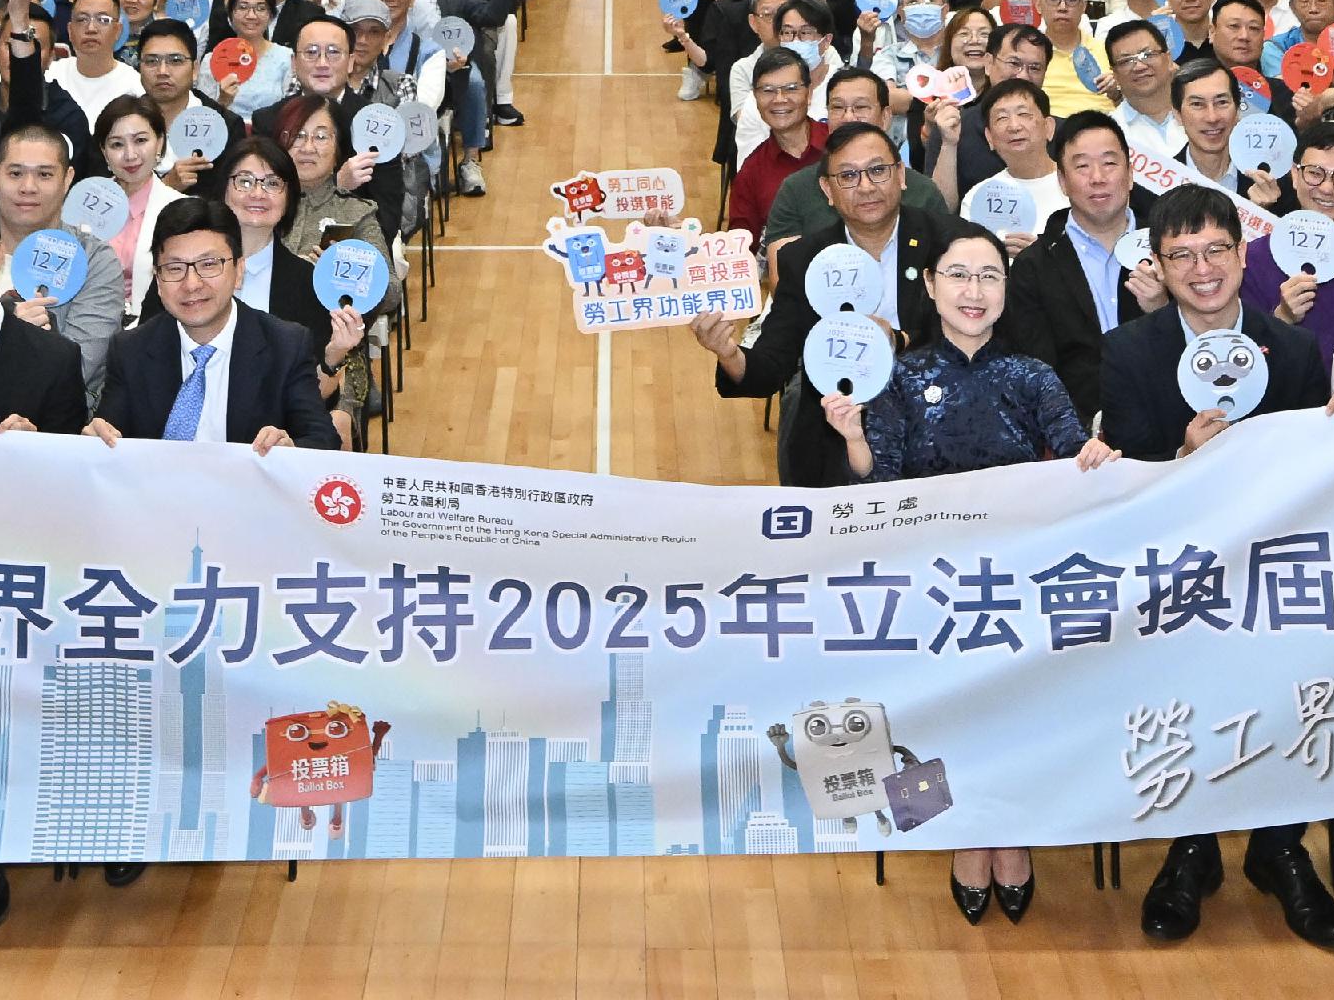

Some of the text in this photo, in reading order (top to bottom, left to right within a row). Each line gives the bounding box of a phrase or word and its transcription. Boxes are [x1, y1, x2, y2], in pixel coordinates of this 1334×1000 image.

[607, 176, 667, 194] 勞工同心
[616, 194, 675, 212] 投選賢能
[702, 236, 747, 258] 12.7
[688, 260, 752, 285] 齊投票
[584, 287, 755, 326] 勞工界功能界別
[381, 492, 460, 510] 勞工及福利局
[383, 476, 593, 507] 中華人民共和國香港特別行政區政府
[381, 508, 513, 526] Labour and Welfare Bureau
[832, 497, 919, 518] 勞工處
[381, 518, 697, 544] The Government of the Hong Kong Special Administrative Region
[830, 511, 989, 536] Labour Department
[393, 530, 408, 538] the
[411, 531, 453, 541] People's
[455, 534, 497, 544] Republic
[512, 538, 540, 546] China
[291, 754, 350, 780] 投票箱
[298, 780, 345, 793] Ballot Box
[823, 768, 876, 794] 投票箱
[832, 788, 875, 802] Ballot Box
